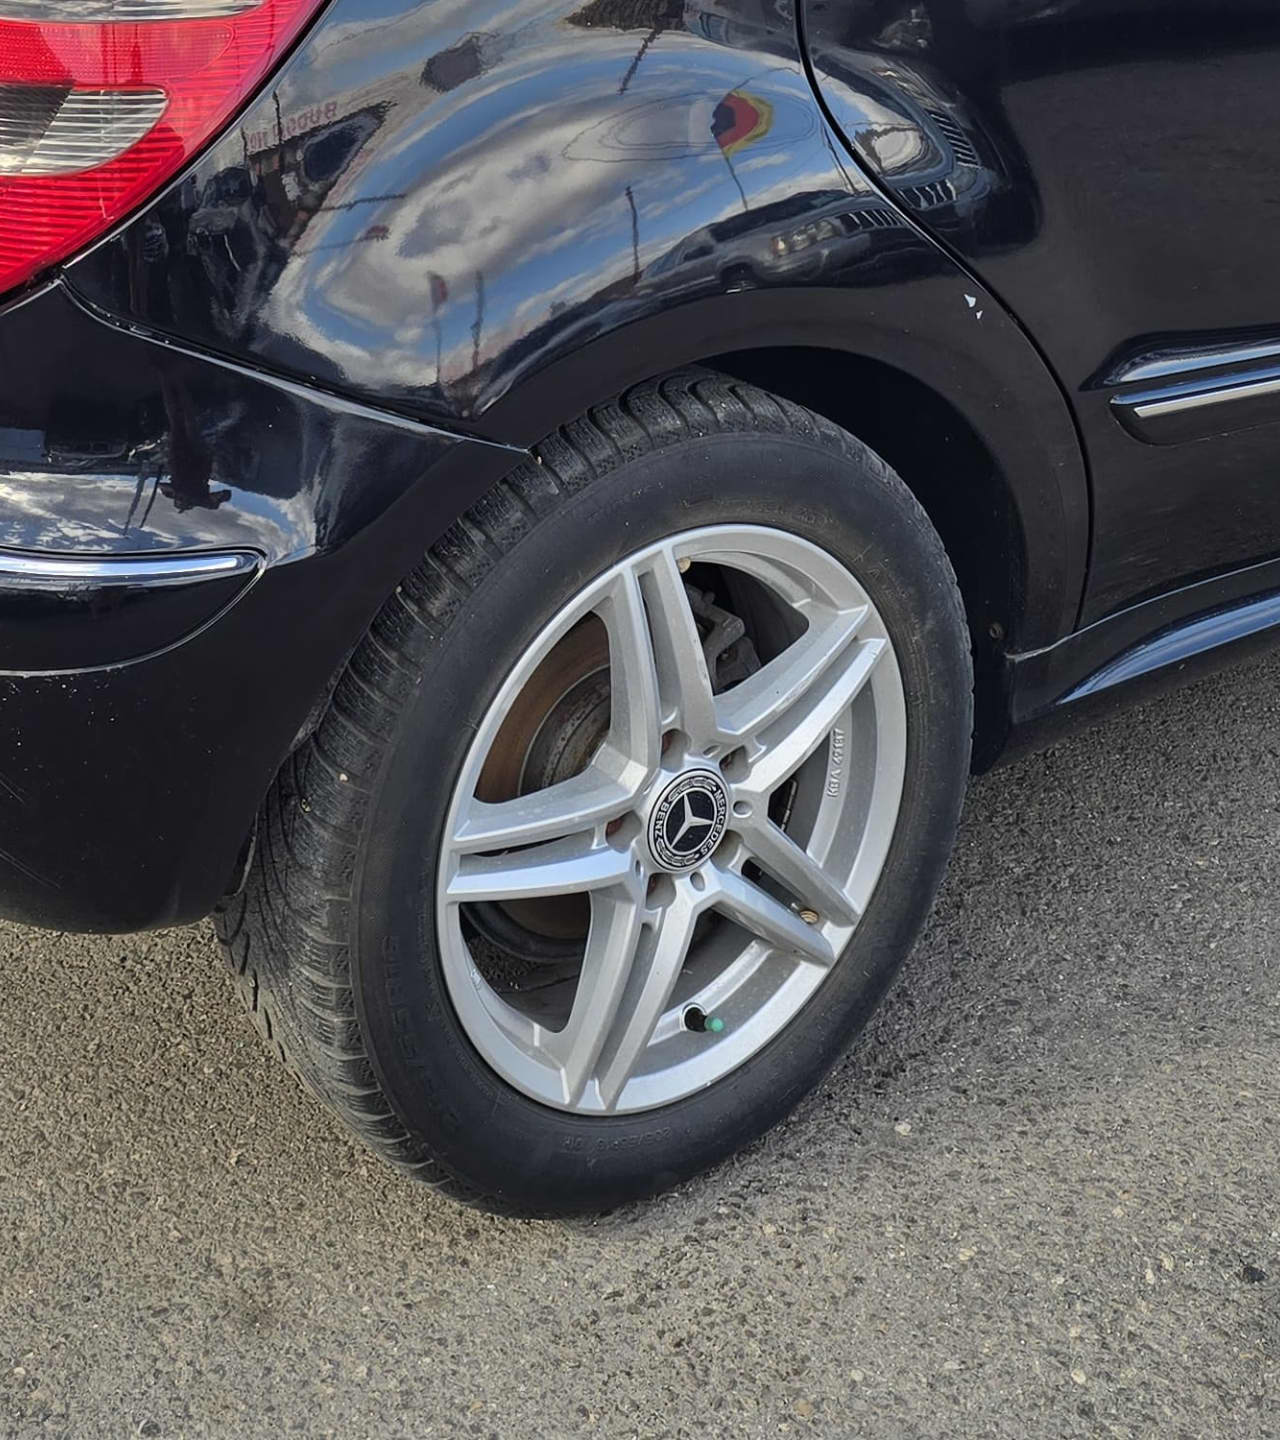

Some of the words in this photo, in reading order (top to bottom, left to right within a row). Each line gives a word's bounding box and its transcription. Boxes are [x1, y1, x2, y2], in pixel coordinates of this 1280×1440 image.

[826, 768, 842, 798] KBA
[655, 802, 670, 840] BENZ
[700, 789, 727, 856] MERCEDES
